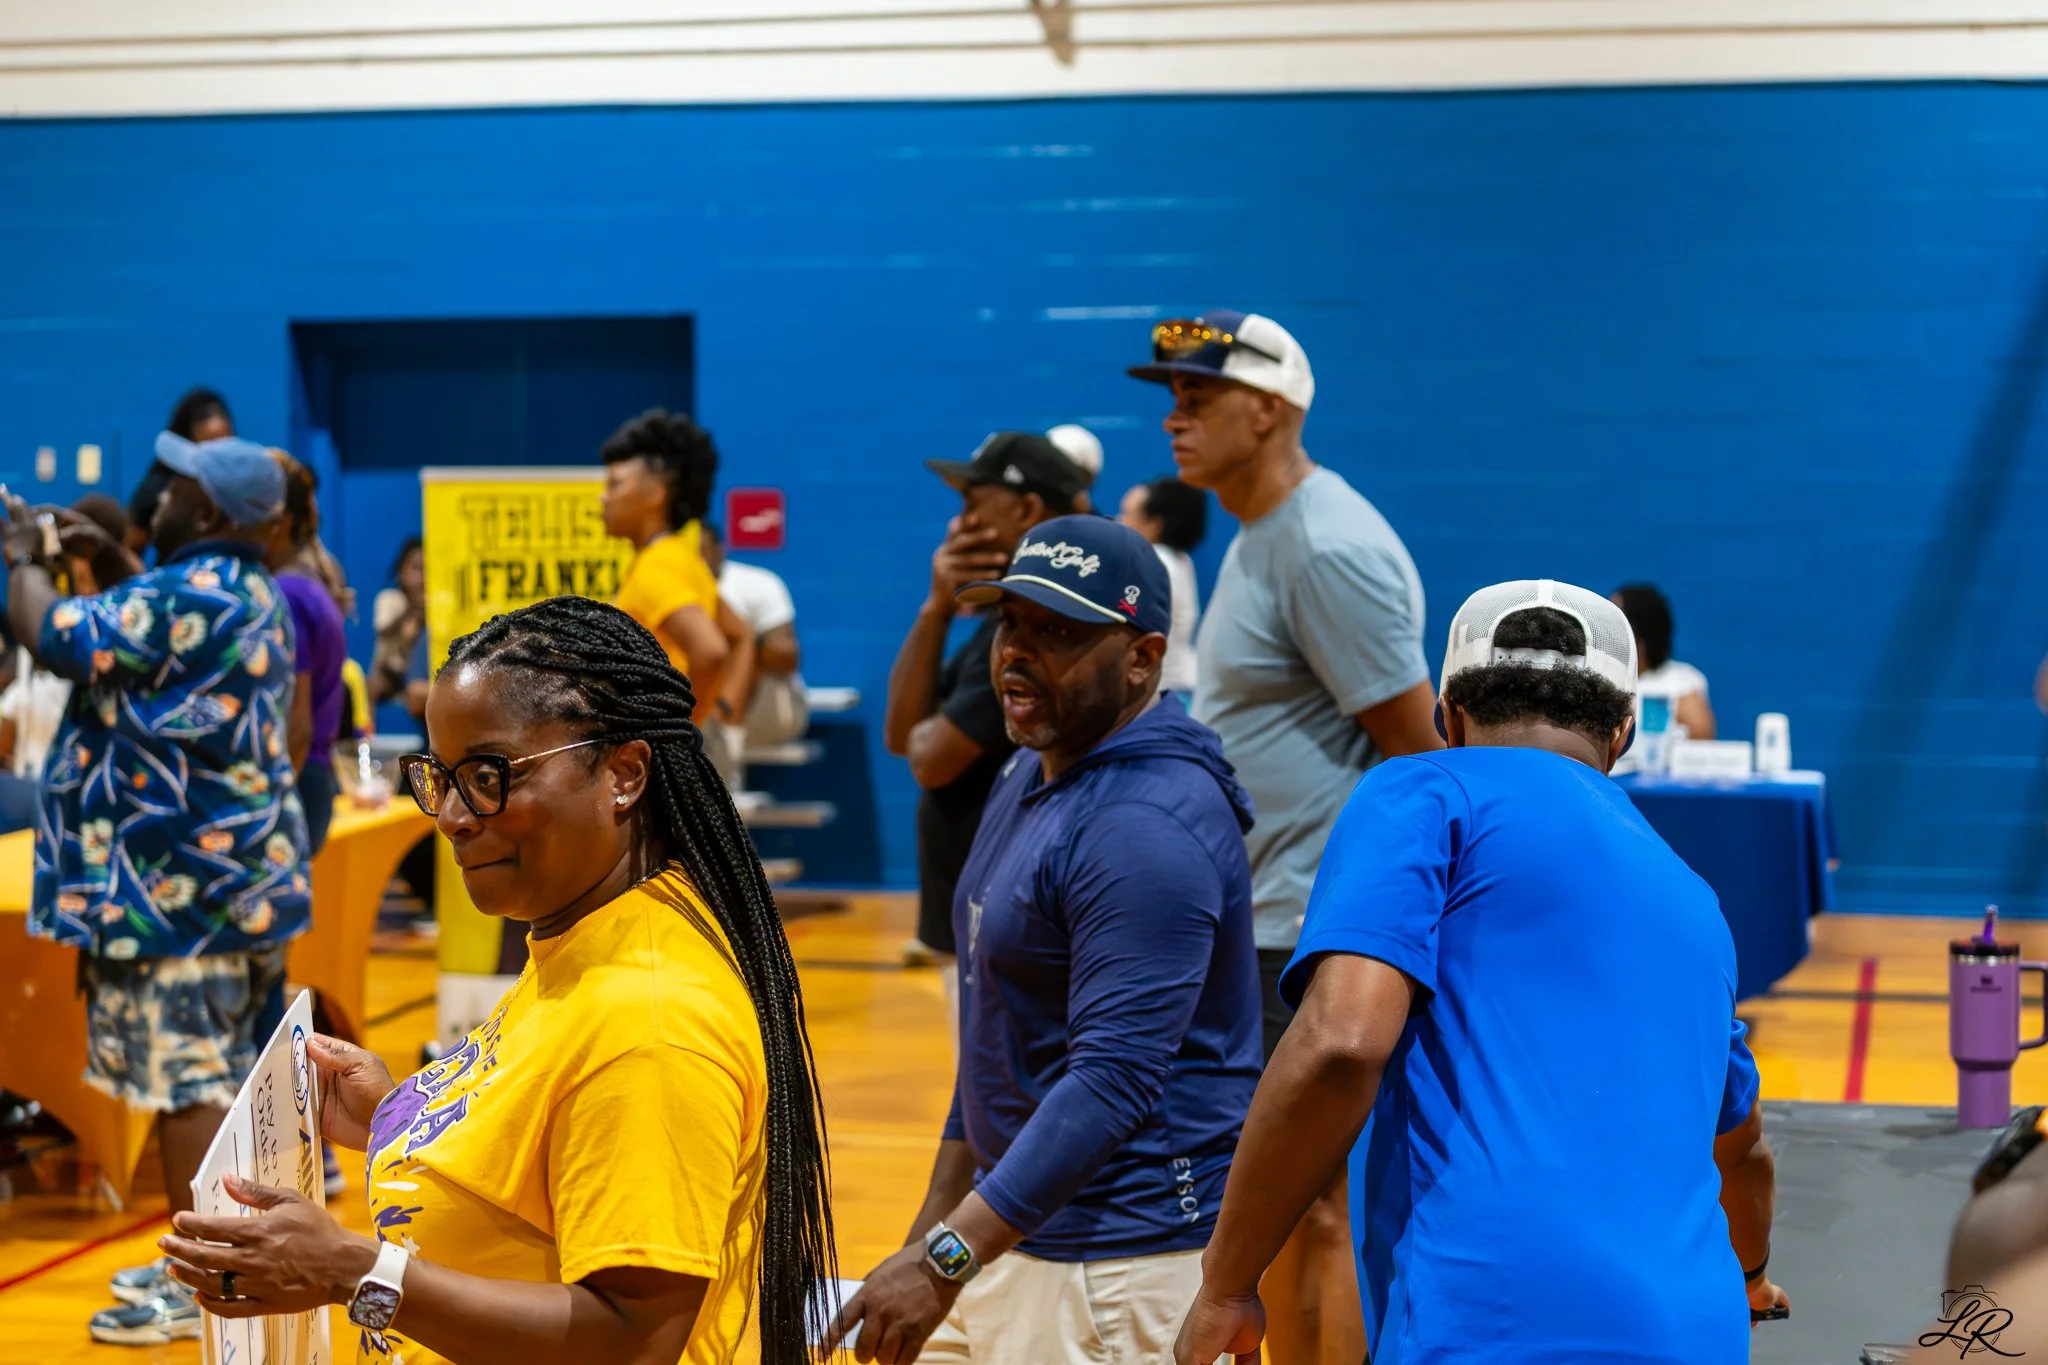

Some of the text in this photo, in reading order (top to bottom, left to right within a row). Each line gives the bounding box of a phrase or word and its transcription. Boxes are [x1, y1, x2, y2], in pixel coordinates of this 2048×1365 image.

[459, 492, 606, 551] TELIS
[265, 1068, 275, 1127] Pay
[257, 1086, 270, 1176] Order
